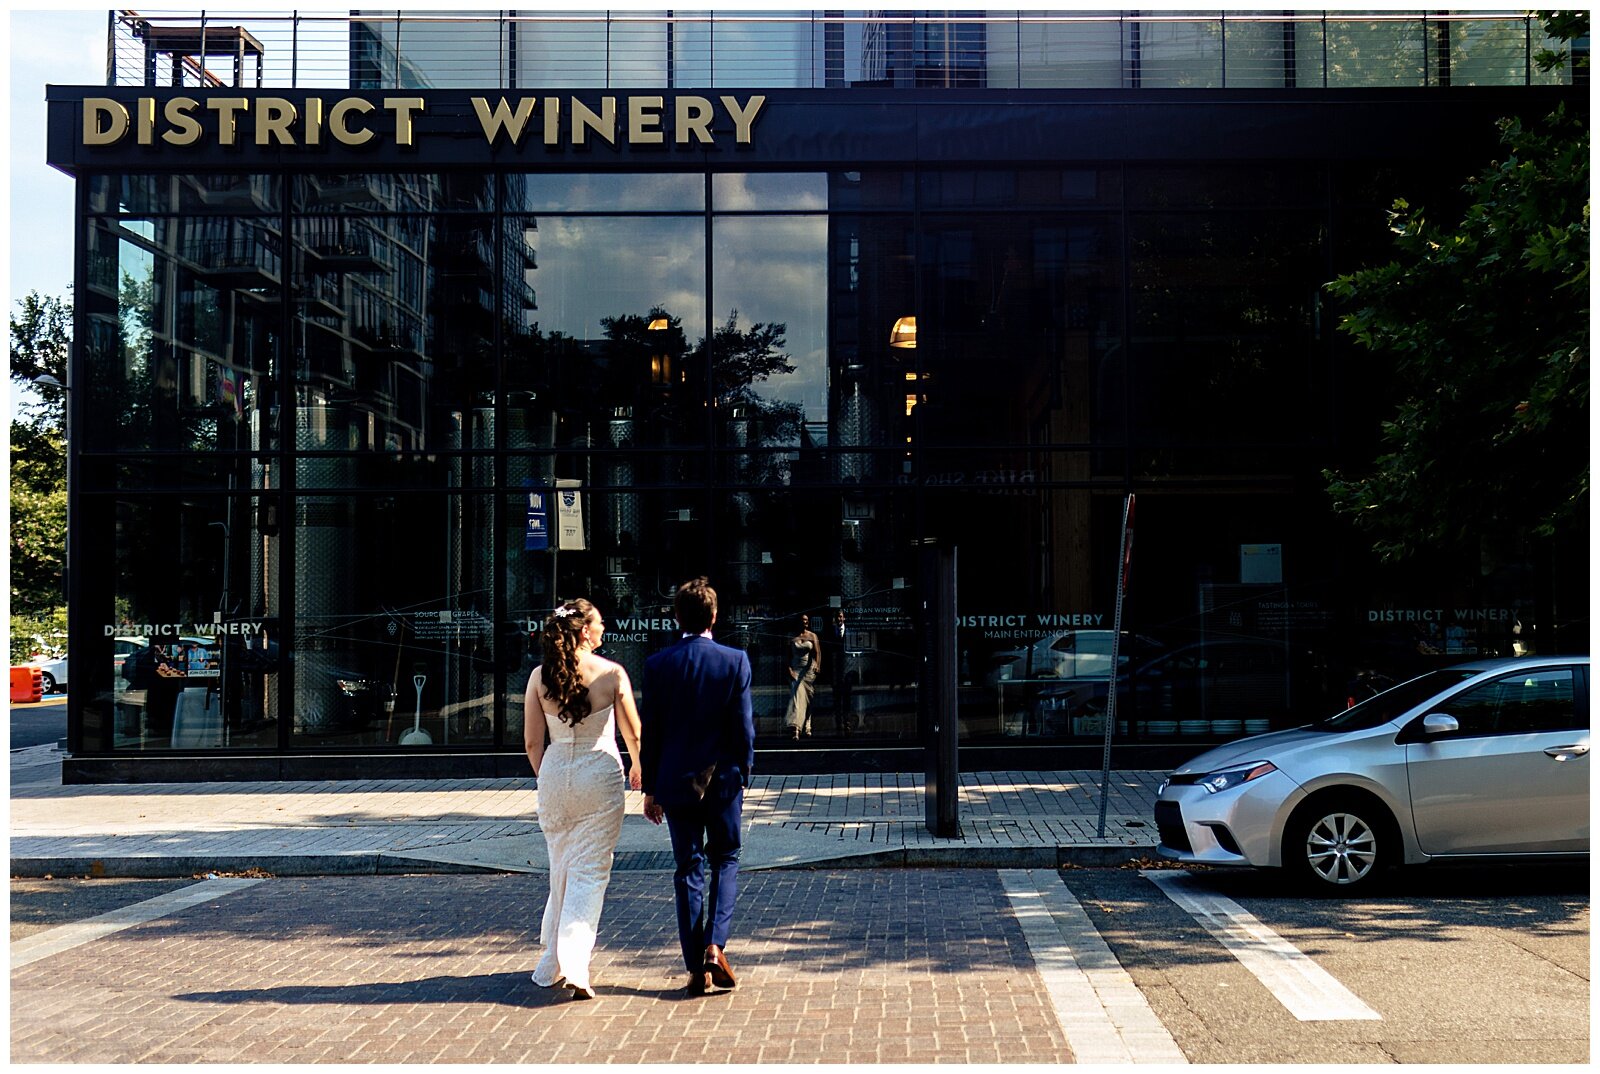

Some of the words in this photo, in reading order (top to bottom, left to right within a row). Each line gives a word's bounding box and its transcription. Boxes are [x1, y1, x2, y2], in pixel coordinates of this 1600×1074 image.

[82, 96, 425, 147] DISTRICT
[470, 95, 767, 146] WINERY
[452, 610, 480, 618] GRAPES
[1036, 614, 1104, 626] WINERY
[1368, 609, 1444, 622] DISTRICT
[1454, 608, 1520, 621] WINERY
[104, 623, 183, 637] DISTRICT
[193, 622, 263, 635] WINERY
[615, 618, 681, 631] WINERY
[602, 633, 648, 643] NTRANCE
[985, 630, 1011, 639] MAIN
[1014, 629, 1070, 638] ENTRANCE
